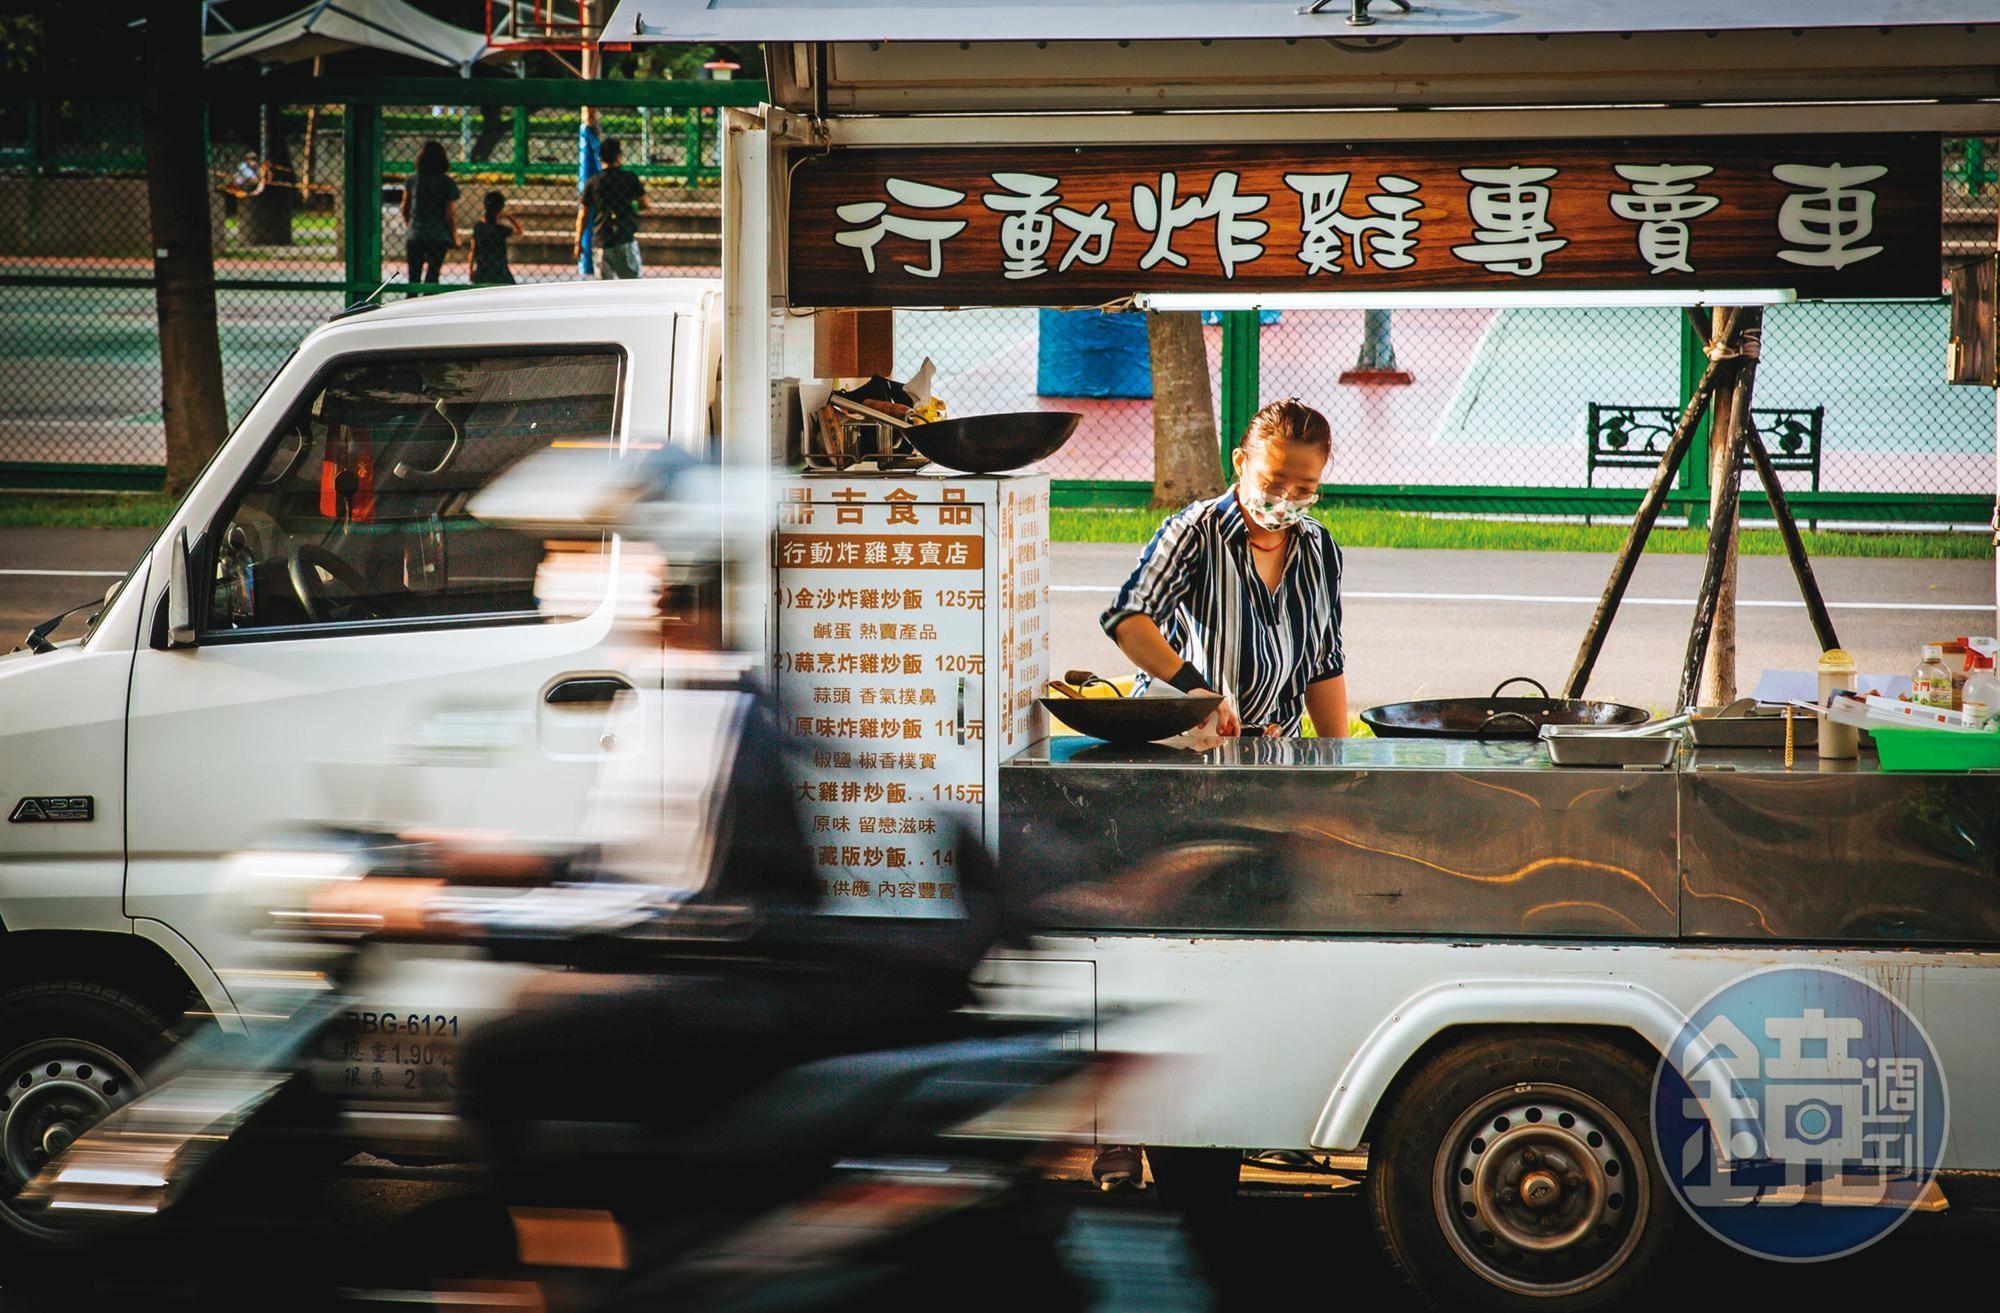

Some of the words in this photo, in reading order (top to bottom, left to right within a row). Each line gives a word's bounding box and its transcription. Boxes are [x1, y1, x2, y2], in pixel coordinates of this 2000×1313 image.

[835, 162, 1888, 278] 行動炸雞專賣車
[780, 486, 973, 525] 鼎吉食品
[783, 540, 968, 565] 行動炸雞專賣店
[935, 589, 986, 611] 125元
[859, 622, 938, 641] 熱賣產品
[935, 653, 986, 675] 120元
[812, 687, 852, 705] 蒜頭
[934, 718, 984, 740] 11元
[932, 783, 984, 805] 115元
[811, 815, 850, 834] 原味
[858, 816, 937, 835] 留戀滋味
[931, 848, 962, 867] 14
